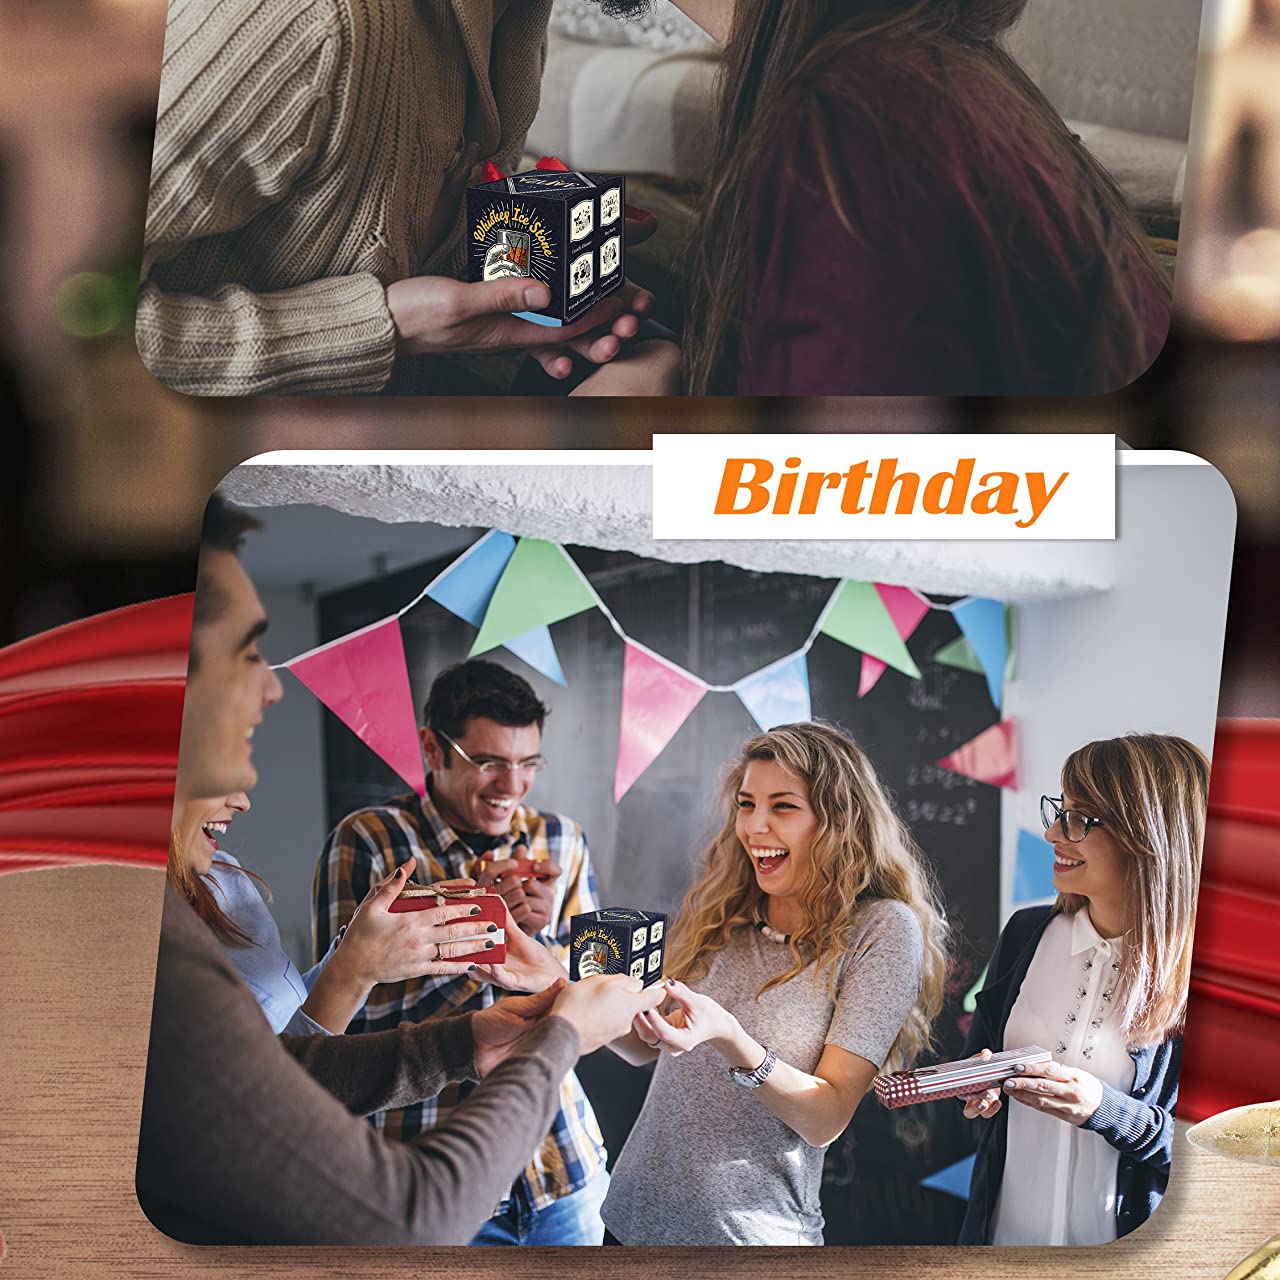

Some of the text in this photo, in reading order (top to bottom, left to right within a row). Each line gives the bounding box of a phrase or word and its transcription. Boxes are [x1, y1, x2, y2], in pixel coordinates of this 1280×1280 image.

[473, 207, 552, 257] Whiskey Ice Stone
